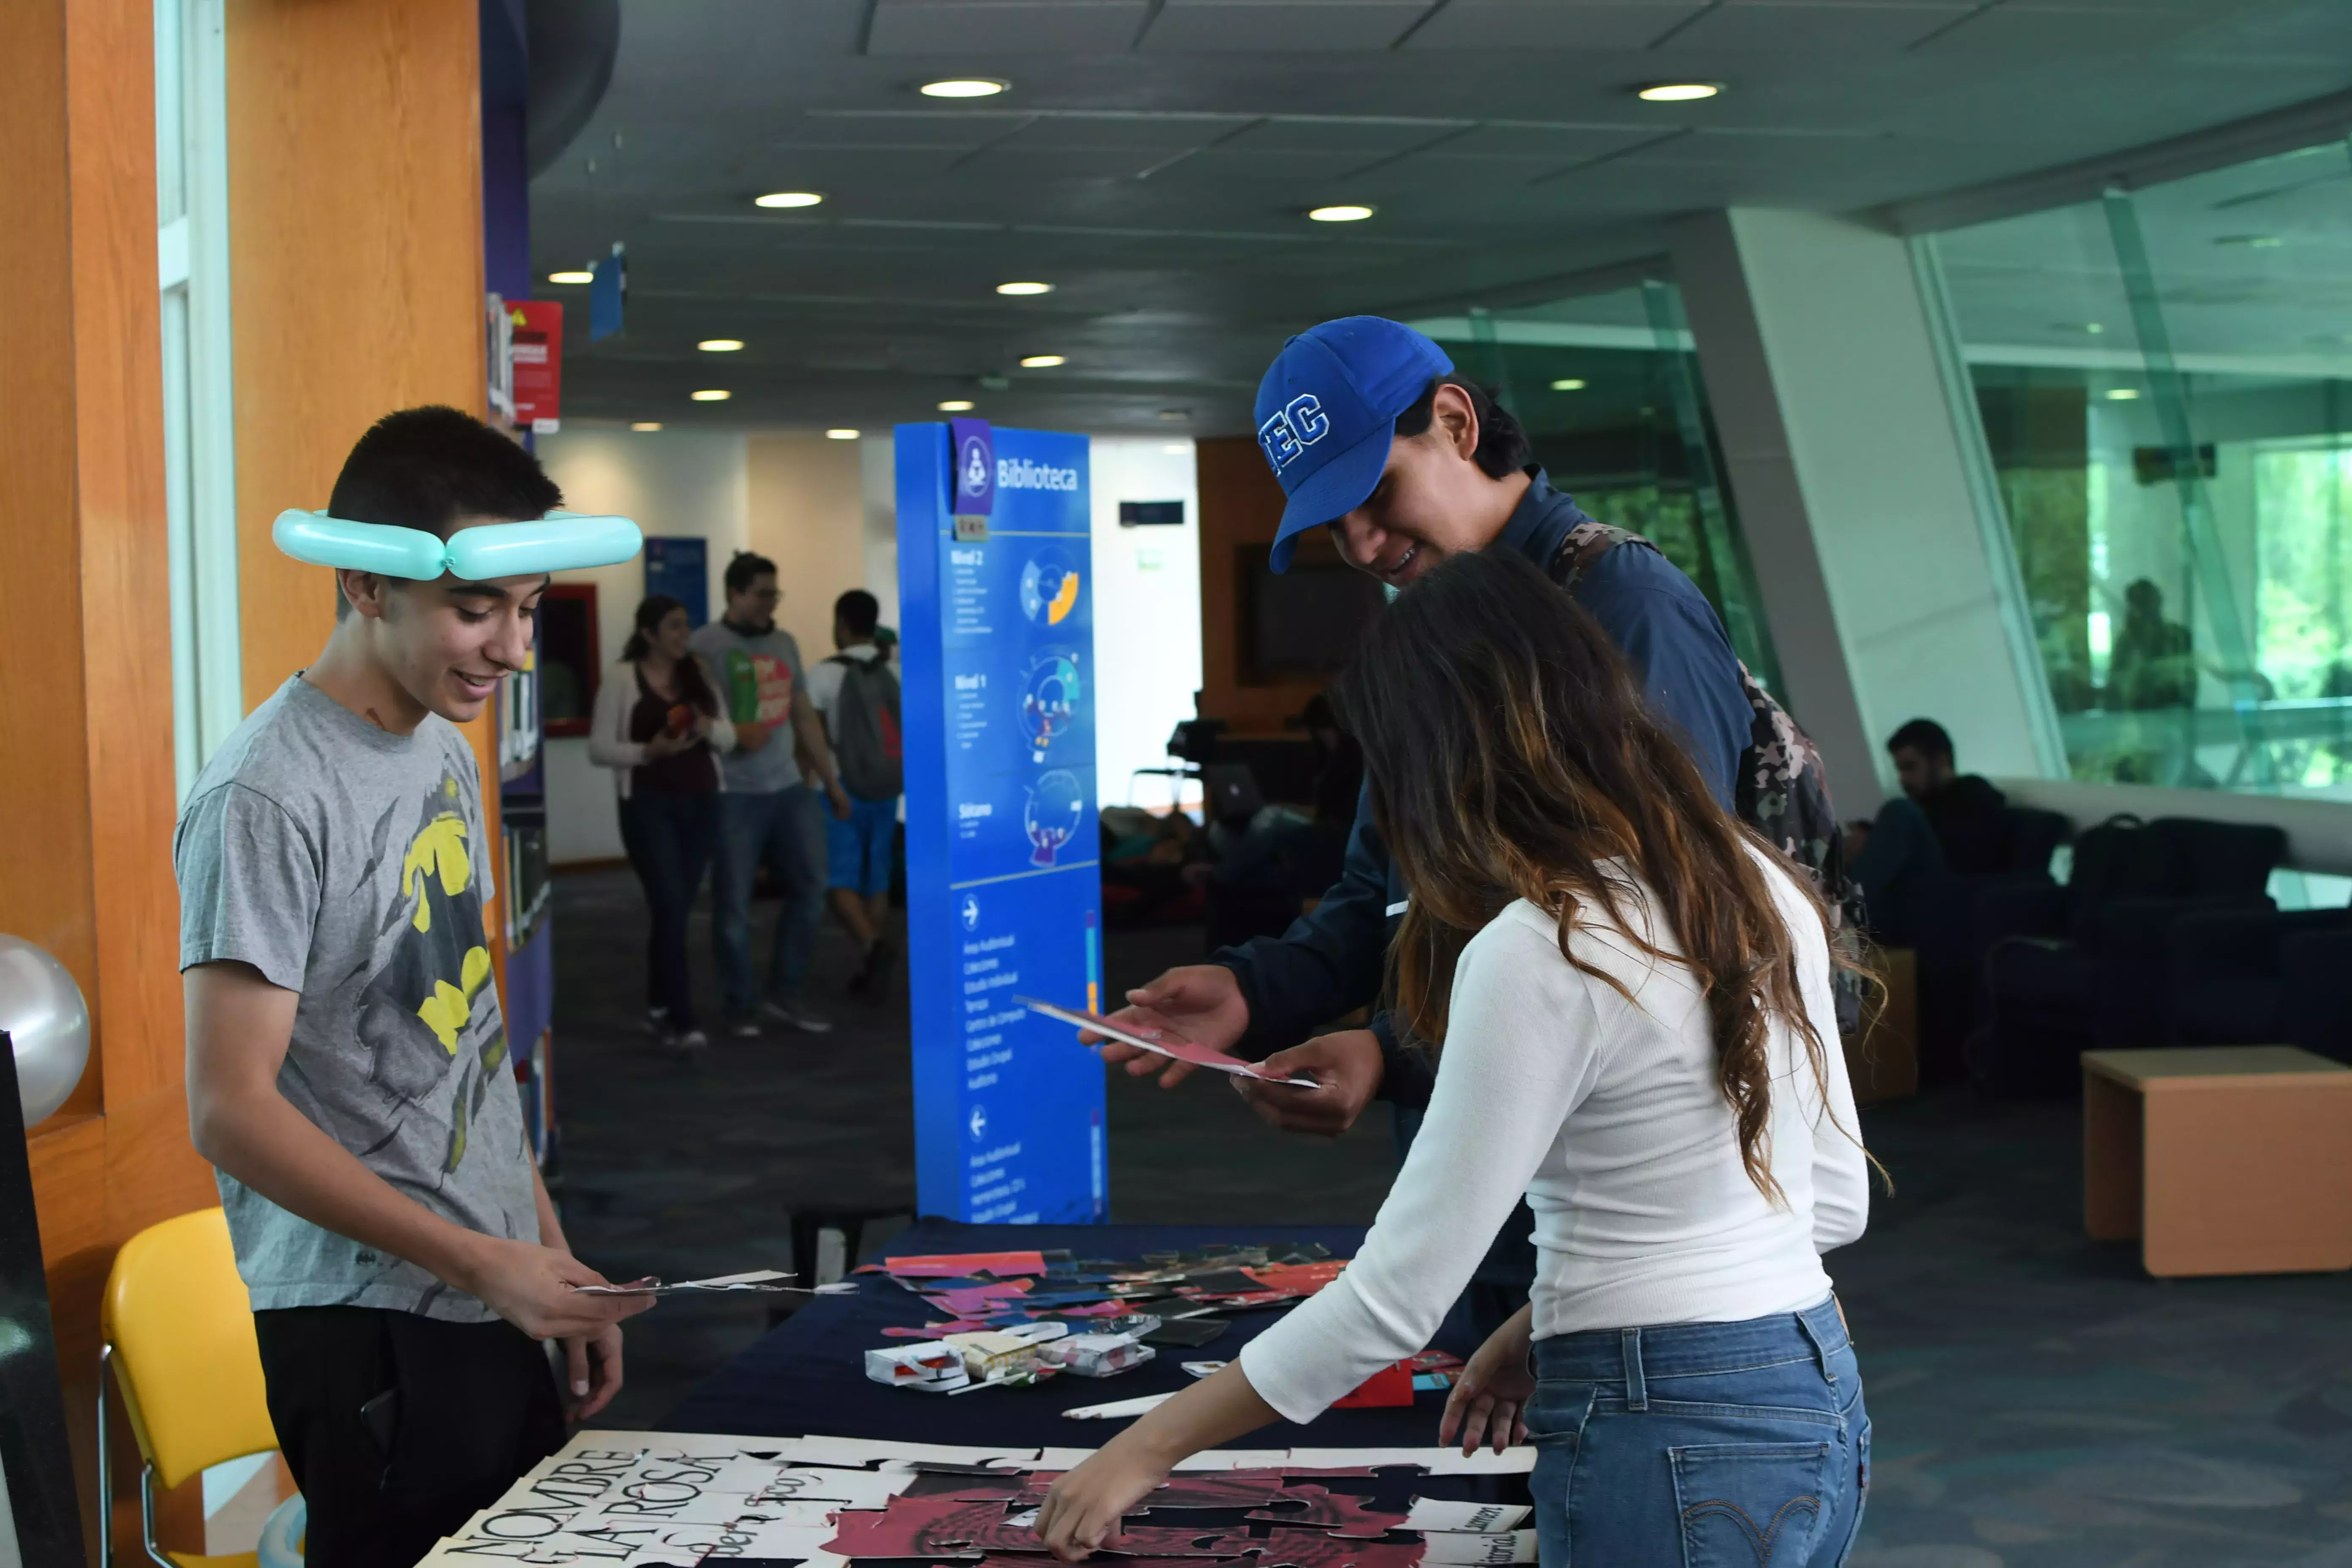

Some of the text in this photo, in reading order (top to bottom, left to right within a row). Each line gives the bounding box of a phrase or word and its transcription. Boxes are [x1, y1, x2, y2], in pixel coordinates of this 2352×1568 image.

[998, 458, 1077, 490] Biblioteca
[443, 1449, 650, 1557] NOMBRE
[549, 1454, 739, 1561] LA ROSA
